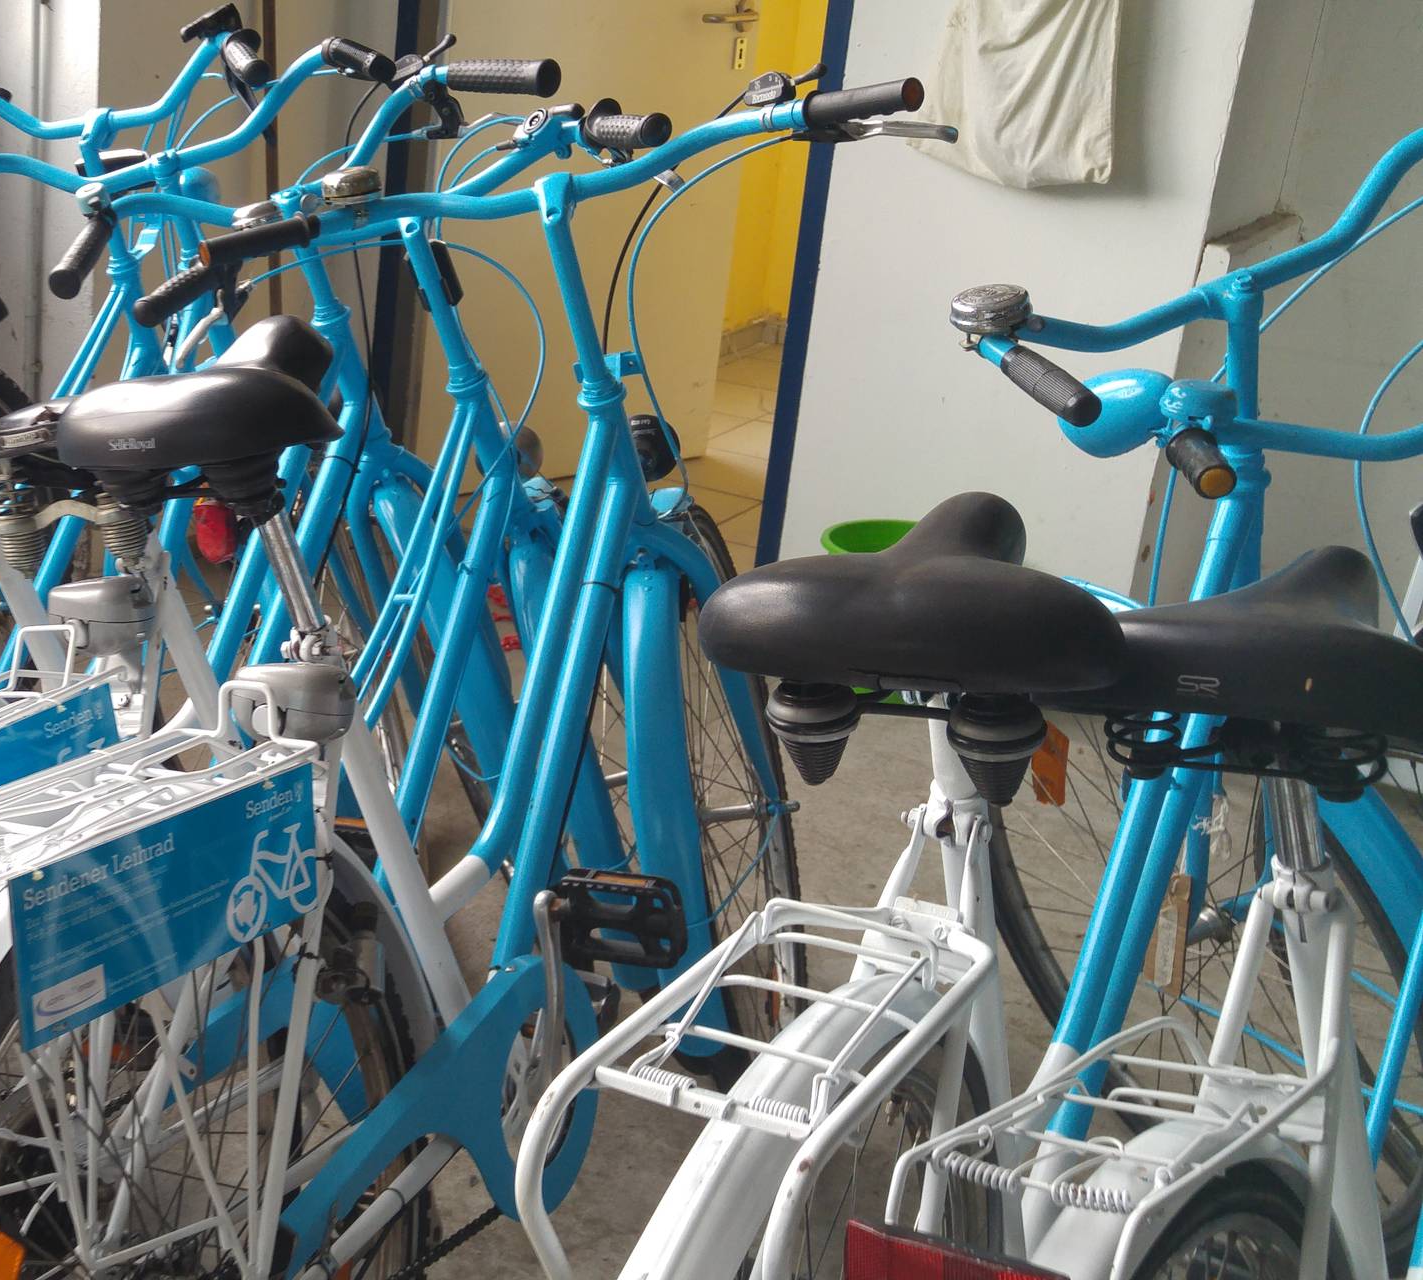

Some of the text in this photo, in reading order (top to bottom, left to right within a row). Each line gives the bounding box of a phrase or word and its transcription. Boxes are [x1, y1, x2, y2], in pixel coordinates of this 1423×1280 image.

[44, 708, 94, 739] Senden
[245, 789, 293, 819] Senden
[24, 863, 109, 911] Sendener
[112, 832, 175, 874] Leihrad
